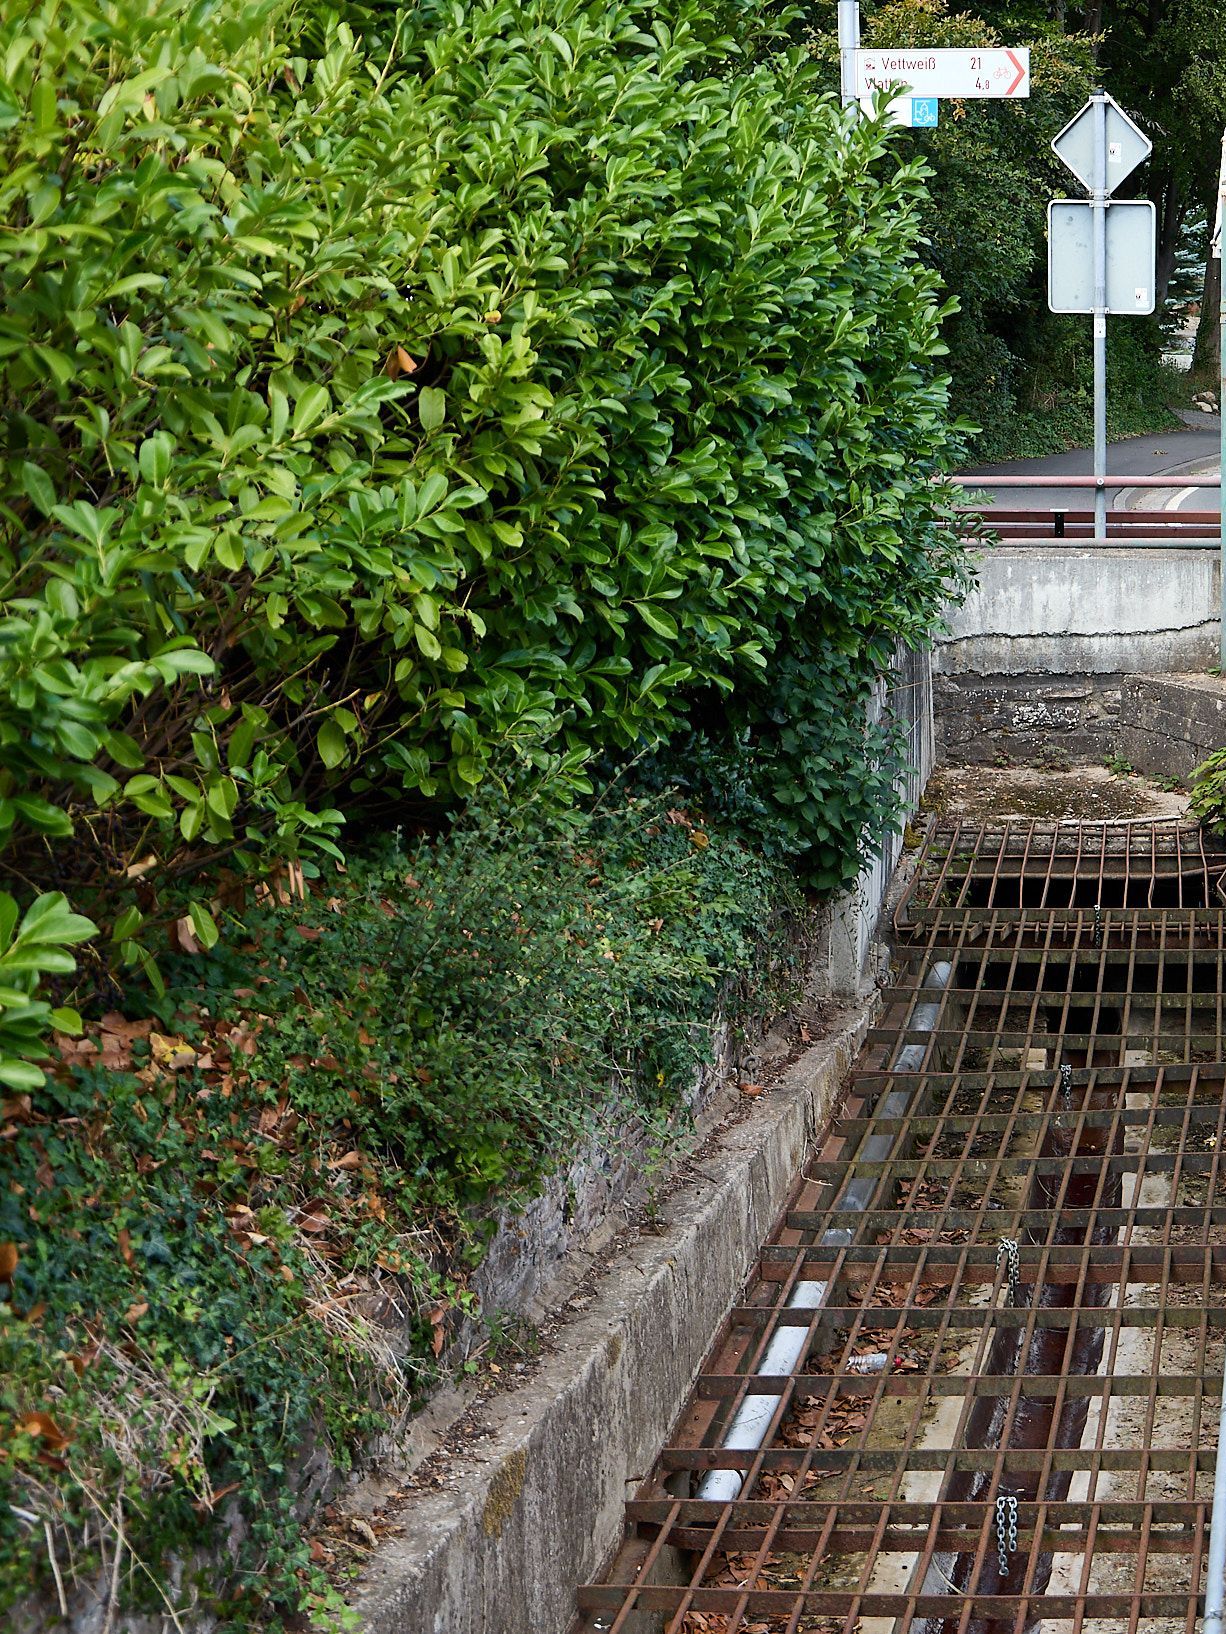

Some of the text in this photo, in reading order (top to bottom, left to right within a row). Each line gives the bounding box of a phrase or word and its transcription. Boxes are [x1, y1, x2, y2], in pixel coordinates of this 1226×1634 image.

[881, 57, 981, 70] Vettweiß 21
[864, 77, 908, 90] Vlattn
